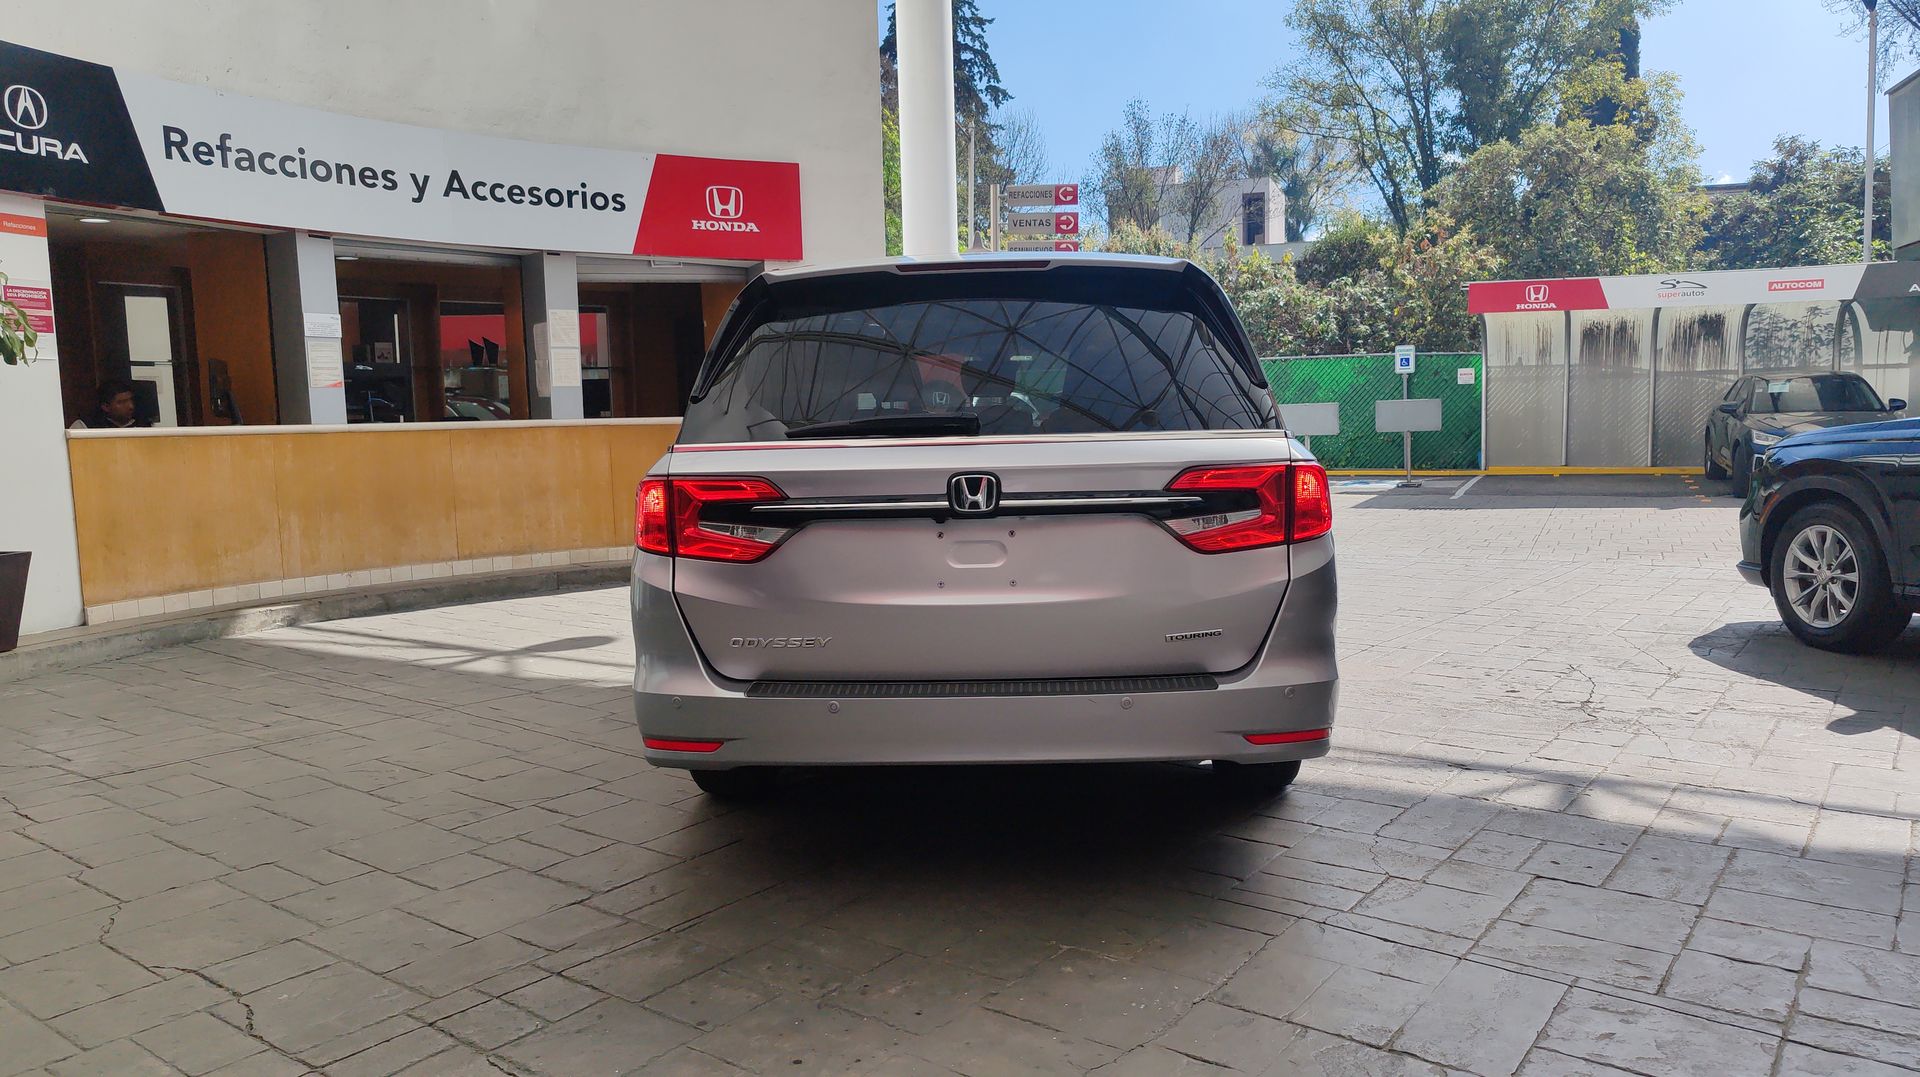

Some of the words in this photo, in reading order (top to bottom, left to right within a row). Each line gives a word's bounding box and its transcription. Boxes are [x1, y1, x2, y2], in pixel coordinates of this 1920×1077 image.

[162, 125, 399, 191] Refacciones
[409, 172, 430, 203] y
[443, 169, 626, 213] Accesorios
[1009, 191, 1052, 199] REFACCIONES
[692, 219, 760, 233] HONDA
[1012, 219, 1051, 227] VENTAS
[1771, 281, 1822, 290] AUTOCOM
[1657, 290, 1705, 299] superautos
[1516, 302, 1557, 310] HONDA
[1168, 631, 1221, 641] TOURING
[730, 637, 832, 648] ODYSSEY
